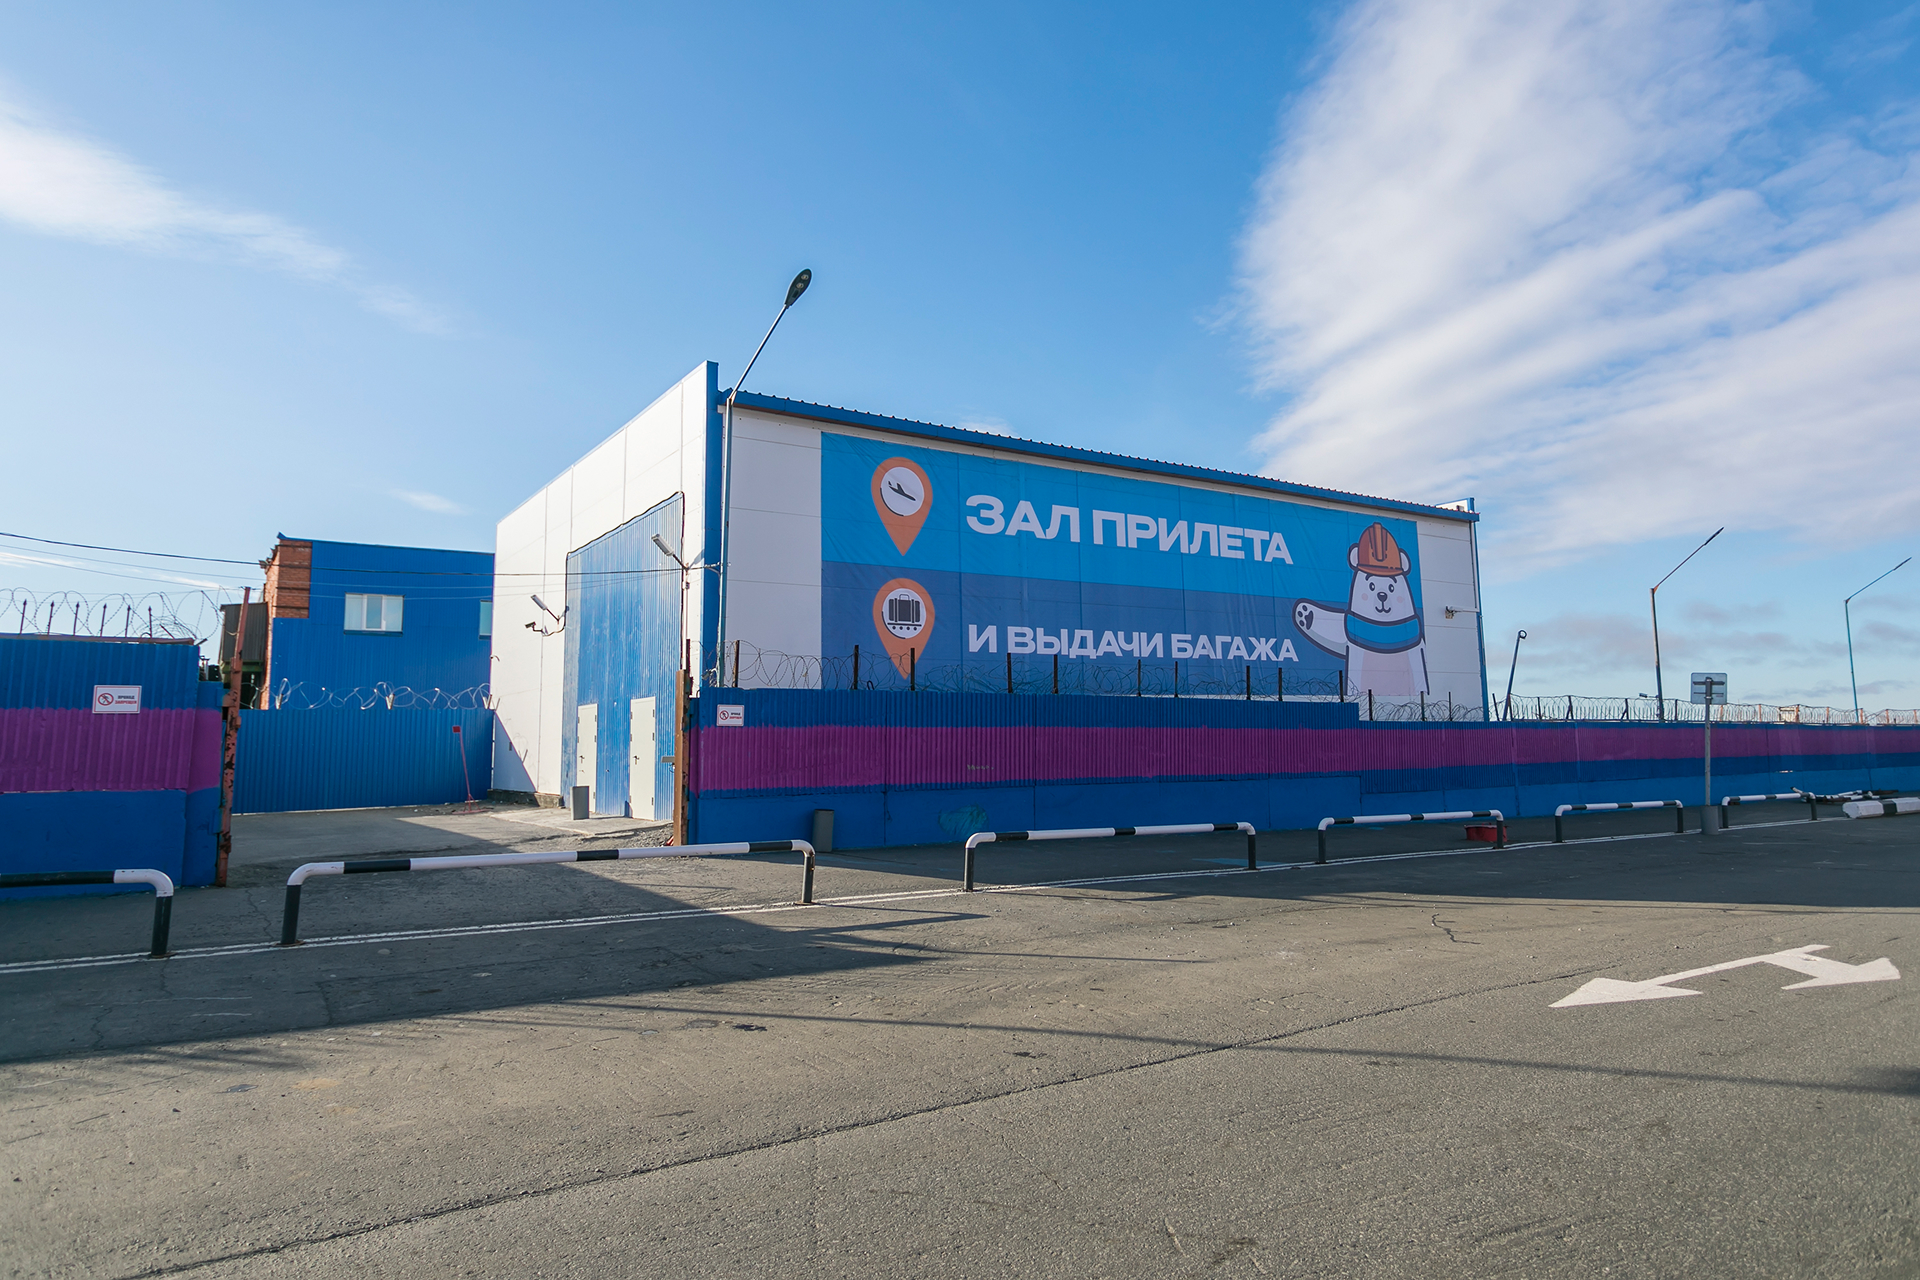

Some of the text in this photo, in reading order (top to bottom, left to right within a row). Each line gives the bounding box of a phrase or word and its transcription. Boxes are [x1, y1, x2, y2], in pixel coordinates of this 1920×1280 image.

[966, 494, 1294, 565] ЗАЛ ПРИЛЕТА
[968, 624, 1299, 662] И ВЫДАЧИ БАГАЖА
